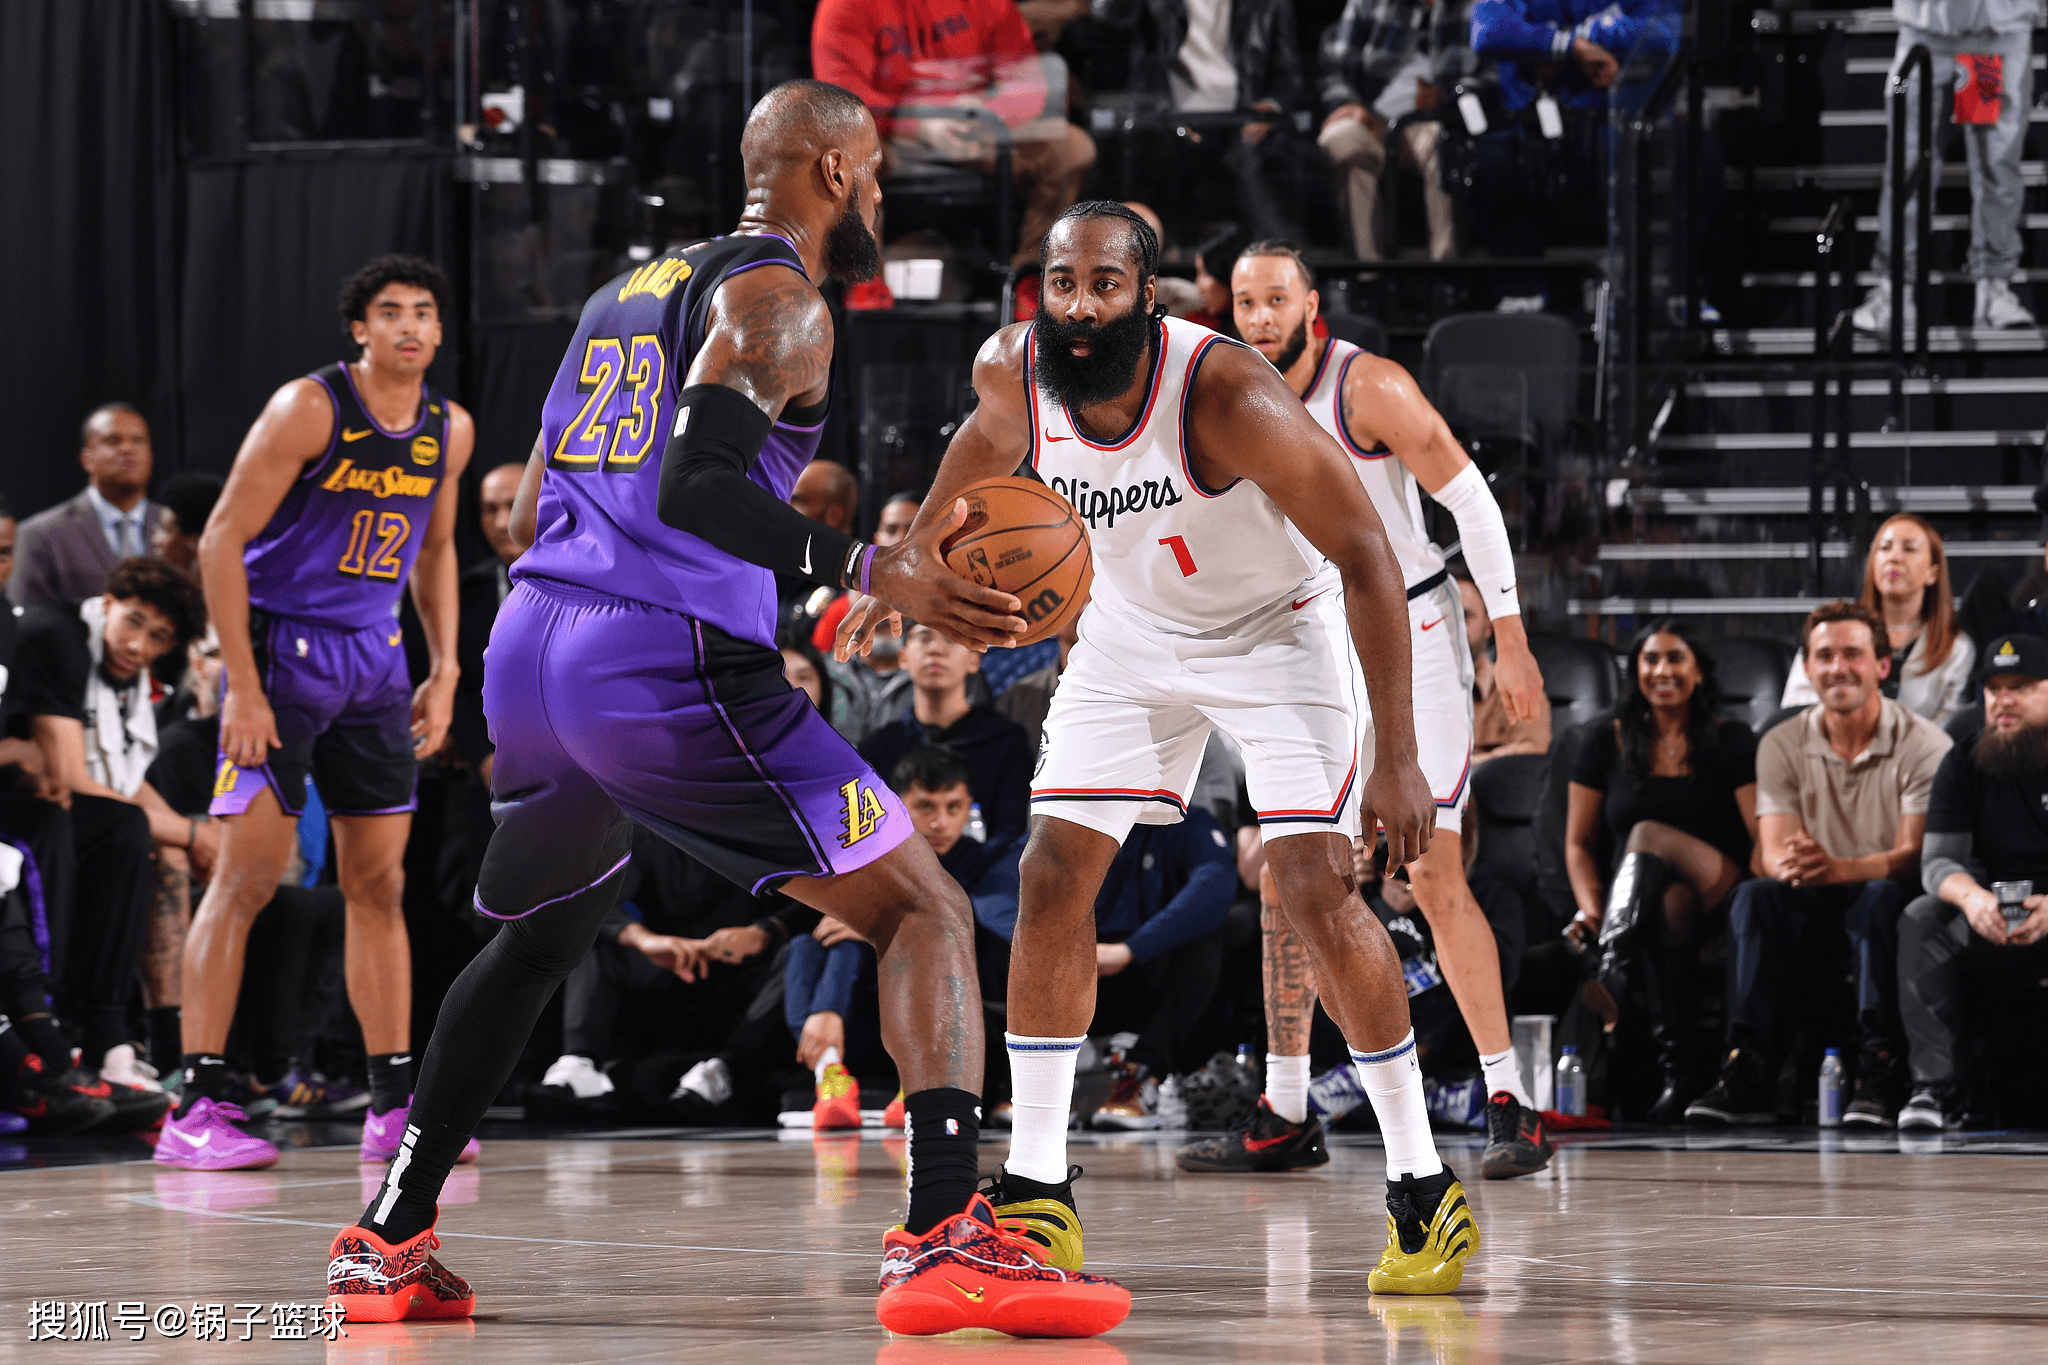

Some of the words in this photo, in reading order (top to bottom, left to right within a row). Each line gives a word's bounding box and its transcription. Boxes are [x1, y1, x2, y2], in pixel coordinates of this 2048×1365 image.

[618, 258, 693, 303] JAMES
[549, 334, 666, 471] 23
[338, 508, 412, 582] 12
[1157, 534, 1199, 578] 1
[837, 777, 887, 849] LA
